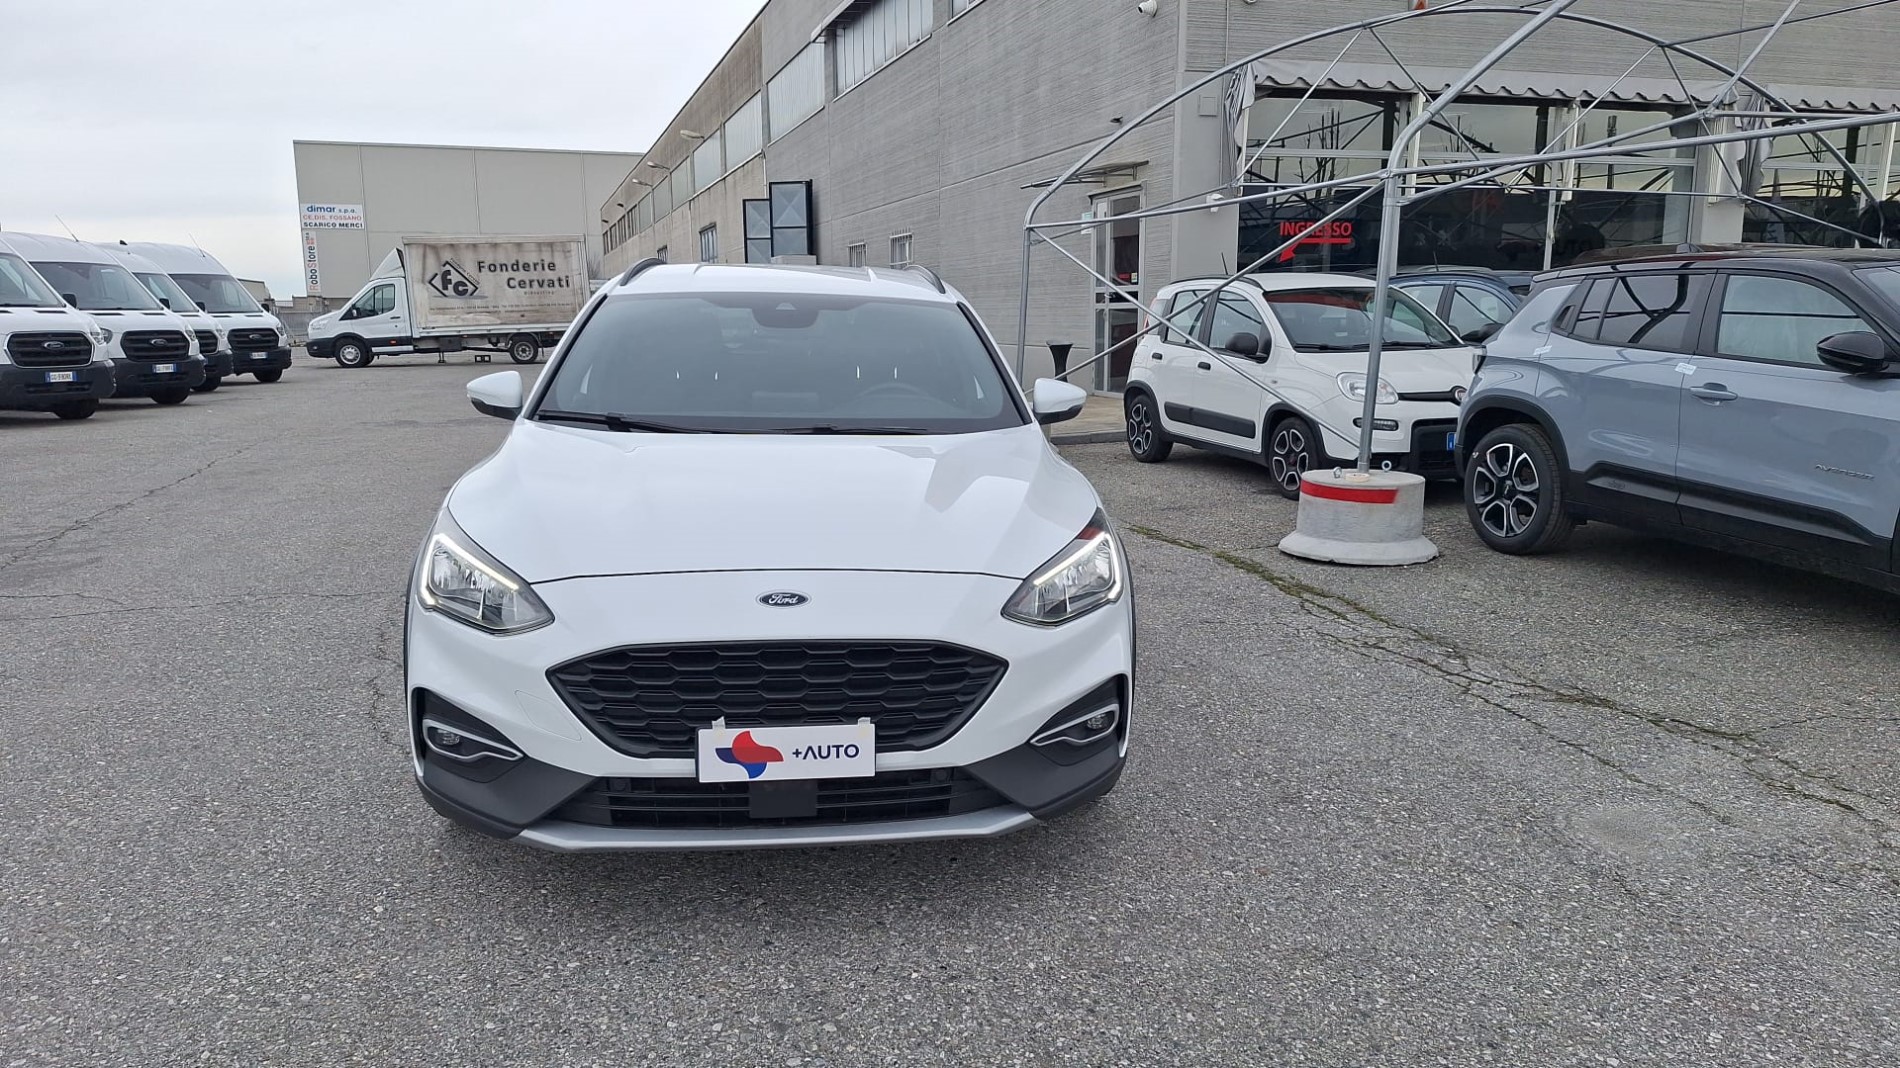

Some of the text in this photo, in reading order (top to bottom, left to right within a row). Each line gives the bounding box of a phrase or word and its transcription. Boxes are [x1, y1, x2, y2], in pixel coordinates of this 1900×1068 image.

[306, 205, 336, 213] dimar
[477, 259, 556, 273] Fonderie
[506, 275, 570, 289] Cervati
[768, 593, 799, 604] Ford
